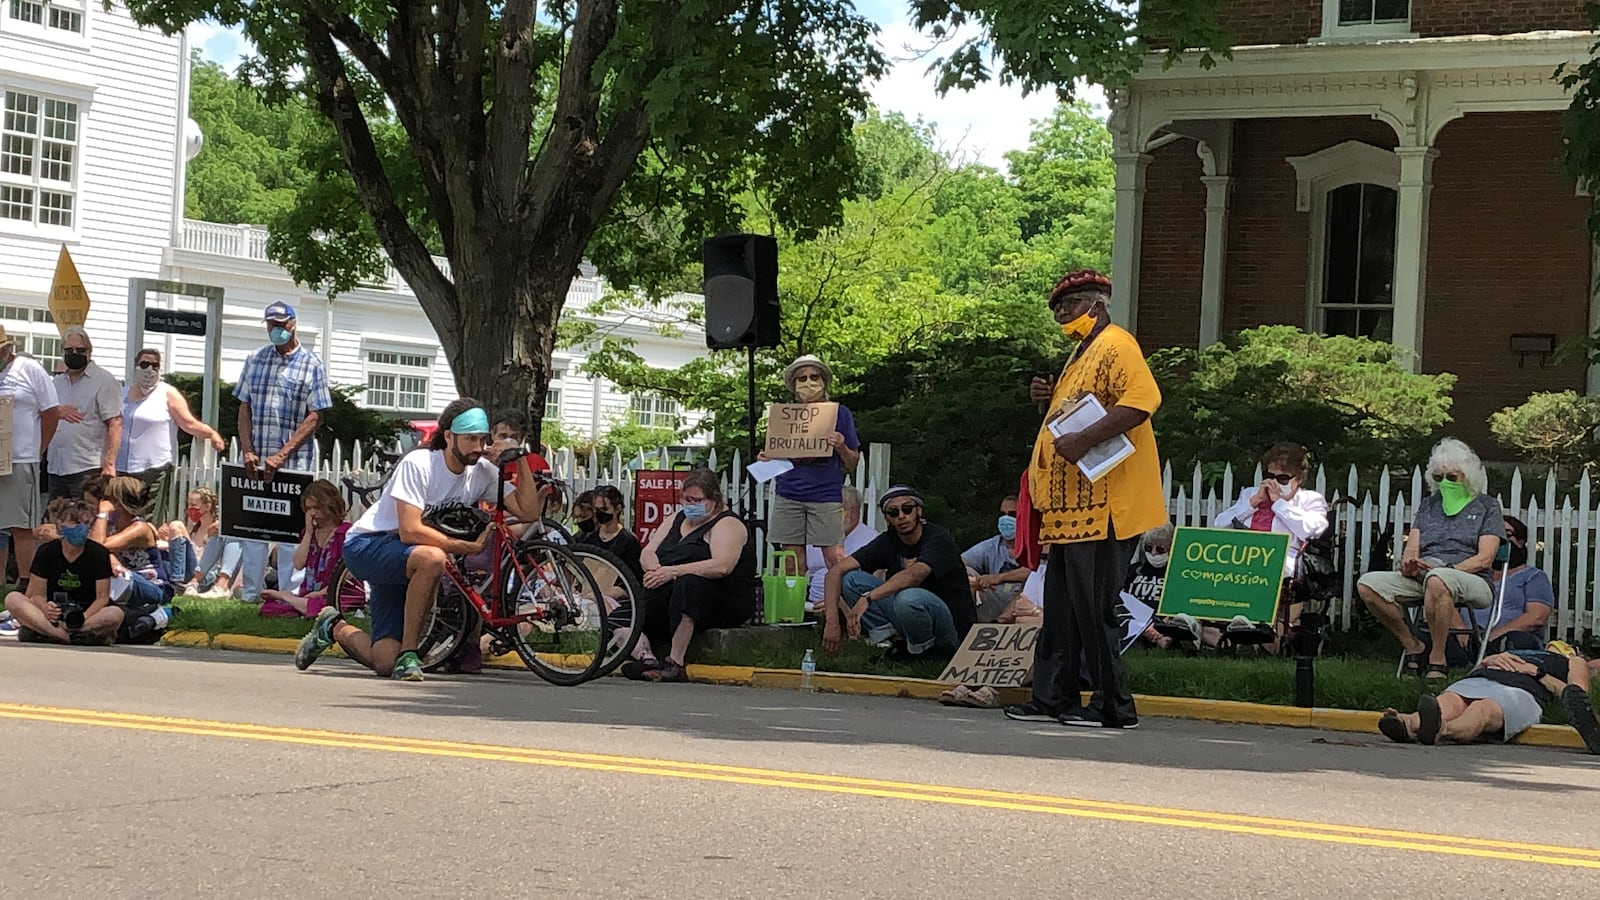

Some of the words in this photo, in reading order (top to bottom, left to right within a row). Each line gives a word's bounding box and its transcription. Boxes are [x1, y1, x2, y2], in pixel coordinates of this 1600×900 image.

[781, 407, 820, 422] STOP
[787, 422, 810, 434] THE
[230, 476, 265, 491] BLACK
[271, 481, 302, 495] LIVES
[640, 479, 664, 489] SALE
[247, 498, 287, 513] MATTER
[644, 502, 659, 523] D
[1186, 542, 1276, 567] OCCUPY
[941, 666, 1028, 685] MATTER
